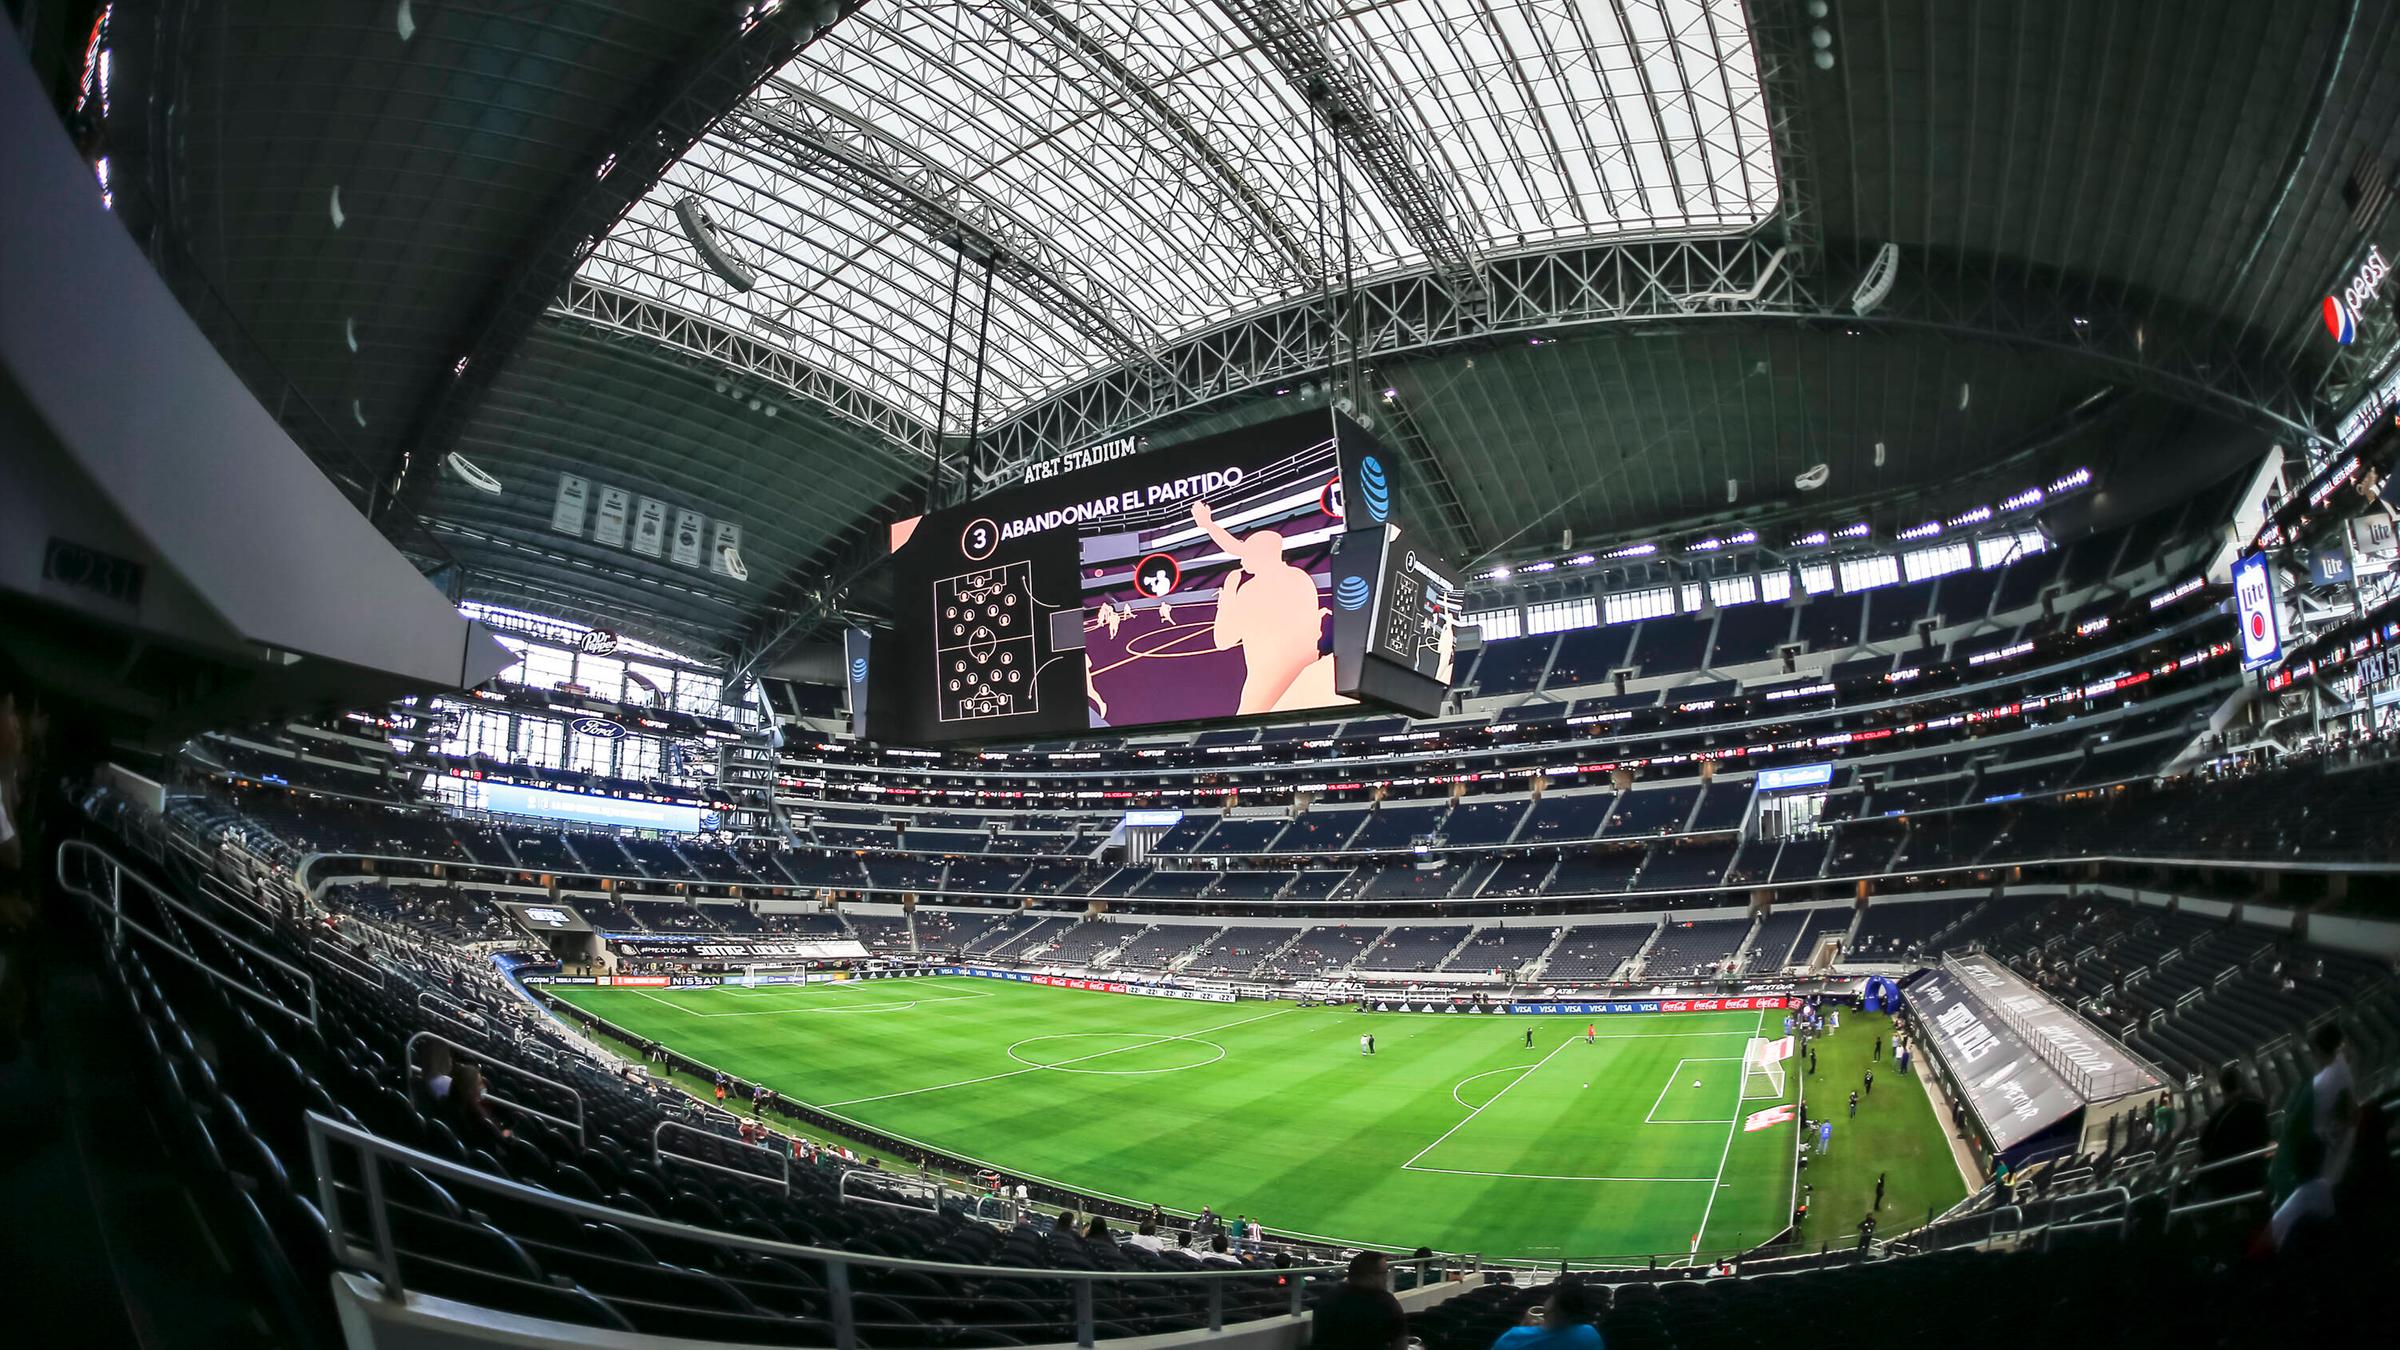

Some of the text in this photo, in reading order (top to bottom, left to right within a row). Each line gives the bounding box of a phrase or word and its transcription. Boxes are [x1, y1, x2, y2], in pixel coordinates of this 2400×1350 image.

[2346, 244, 2390, 322] pepsi
[1024, 436, 1136, 484] AT&T STADIUM
[973, 467, 1243, 549] 3 ABANDONAR EL PARTIDO
[2370, 523, 2390, 545] Lite
[2322, 559, 2344, 579] Lite
[2241, 581, 2264, 611] Lite
[2083, 618, 2109, 634] OPTUM
[582, 633, 616, 654] Pepper
[597, 632, 610, 643] Dr
[1891, 669, 1919, 681] OPTUM
[2356, 652, 2385, 686] AT&T
[1686, 701, 1715, 711] OPTUM
[580, 720, 617, 737] Ford
[1490, 724, 1518, 732] OPTUM
[672, 977, 721, 985] NISSAN
[1743, 983, 1795, 991] #MEXTOUR
[1662, 1001, 1687, 1011] Coca-Cola
[1693, 1000, 1718, 1010] Coca-Cola
[1725, 999, 1749, 1009] Coca-Cola
[1756, 998, 1780, 1008] Coca-Cola
